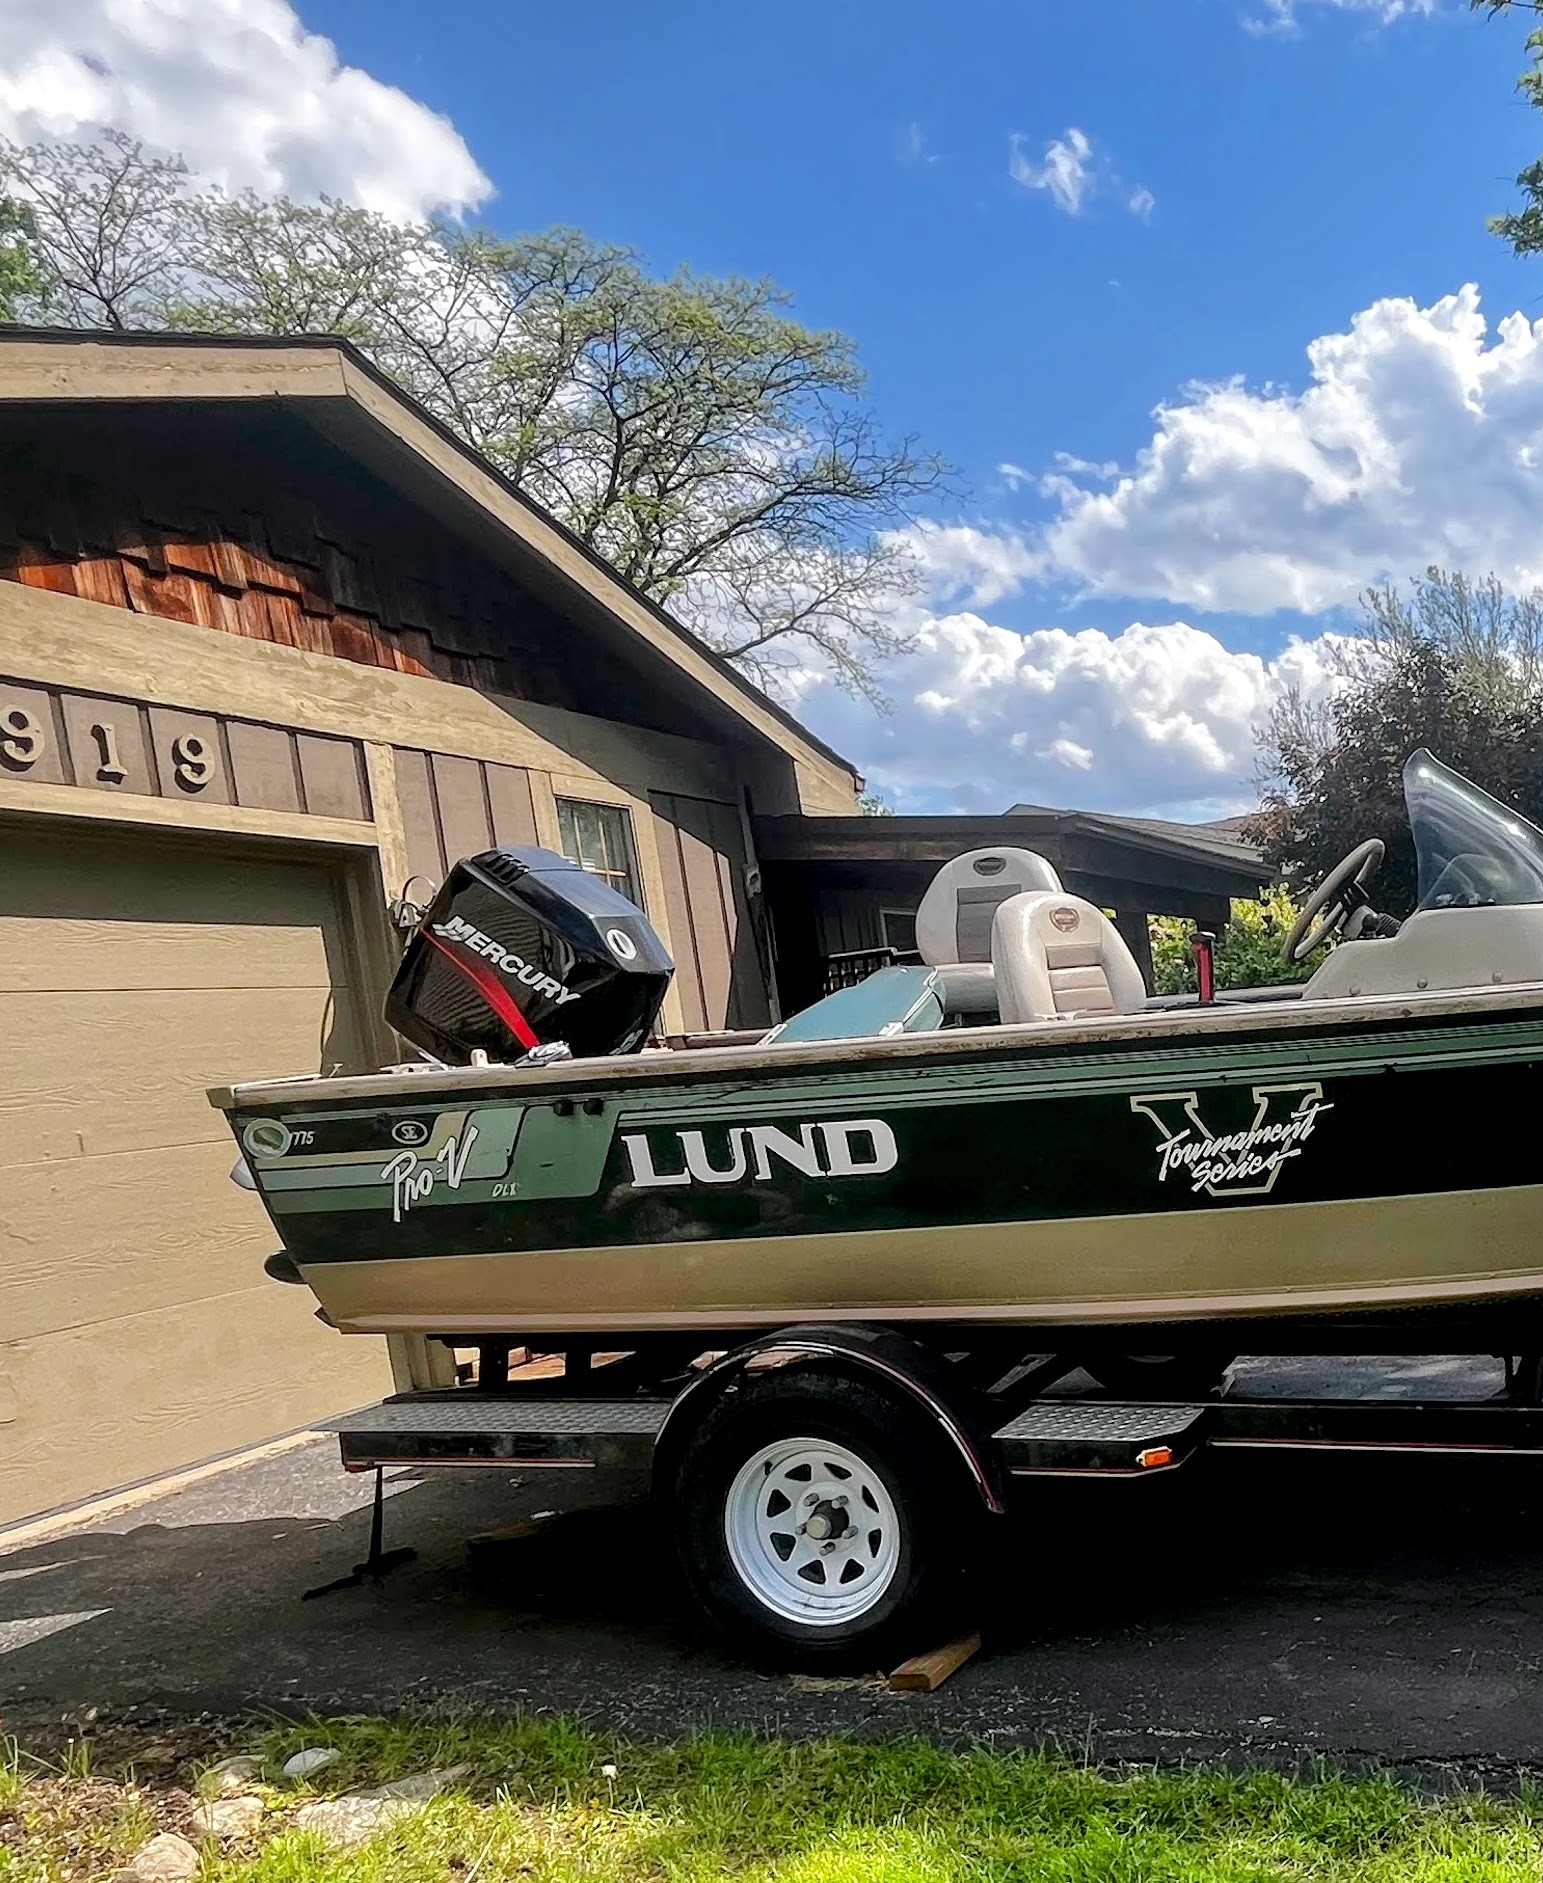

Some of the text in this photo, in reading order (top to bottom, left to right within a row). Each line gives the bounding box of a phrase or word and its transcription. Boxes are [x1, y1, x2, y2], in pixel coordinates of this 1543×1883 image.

[432, 915, 582, 1005] MERCURY
[621, 1119, 899, 1188] LUND
[1156, 1103, 1335, 1182] Tournament
[1191, 1148, 1302, 1192] Series
